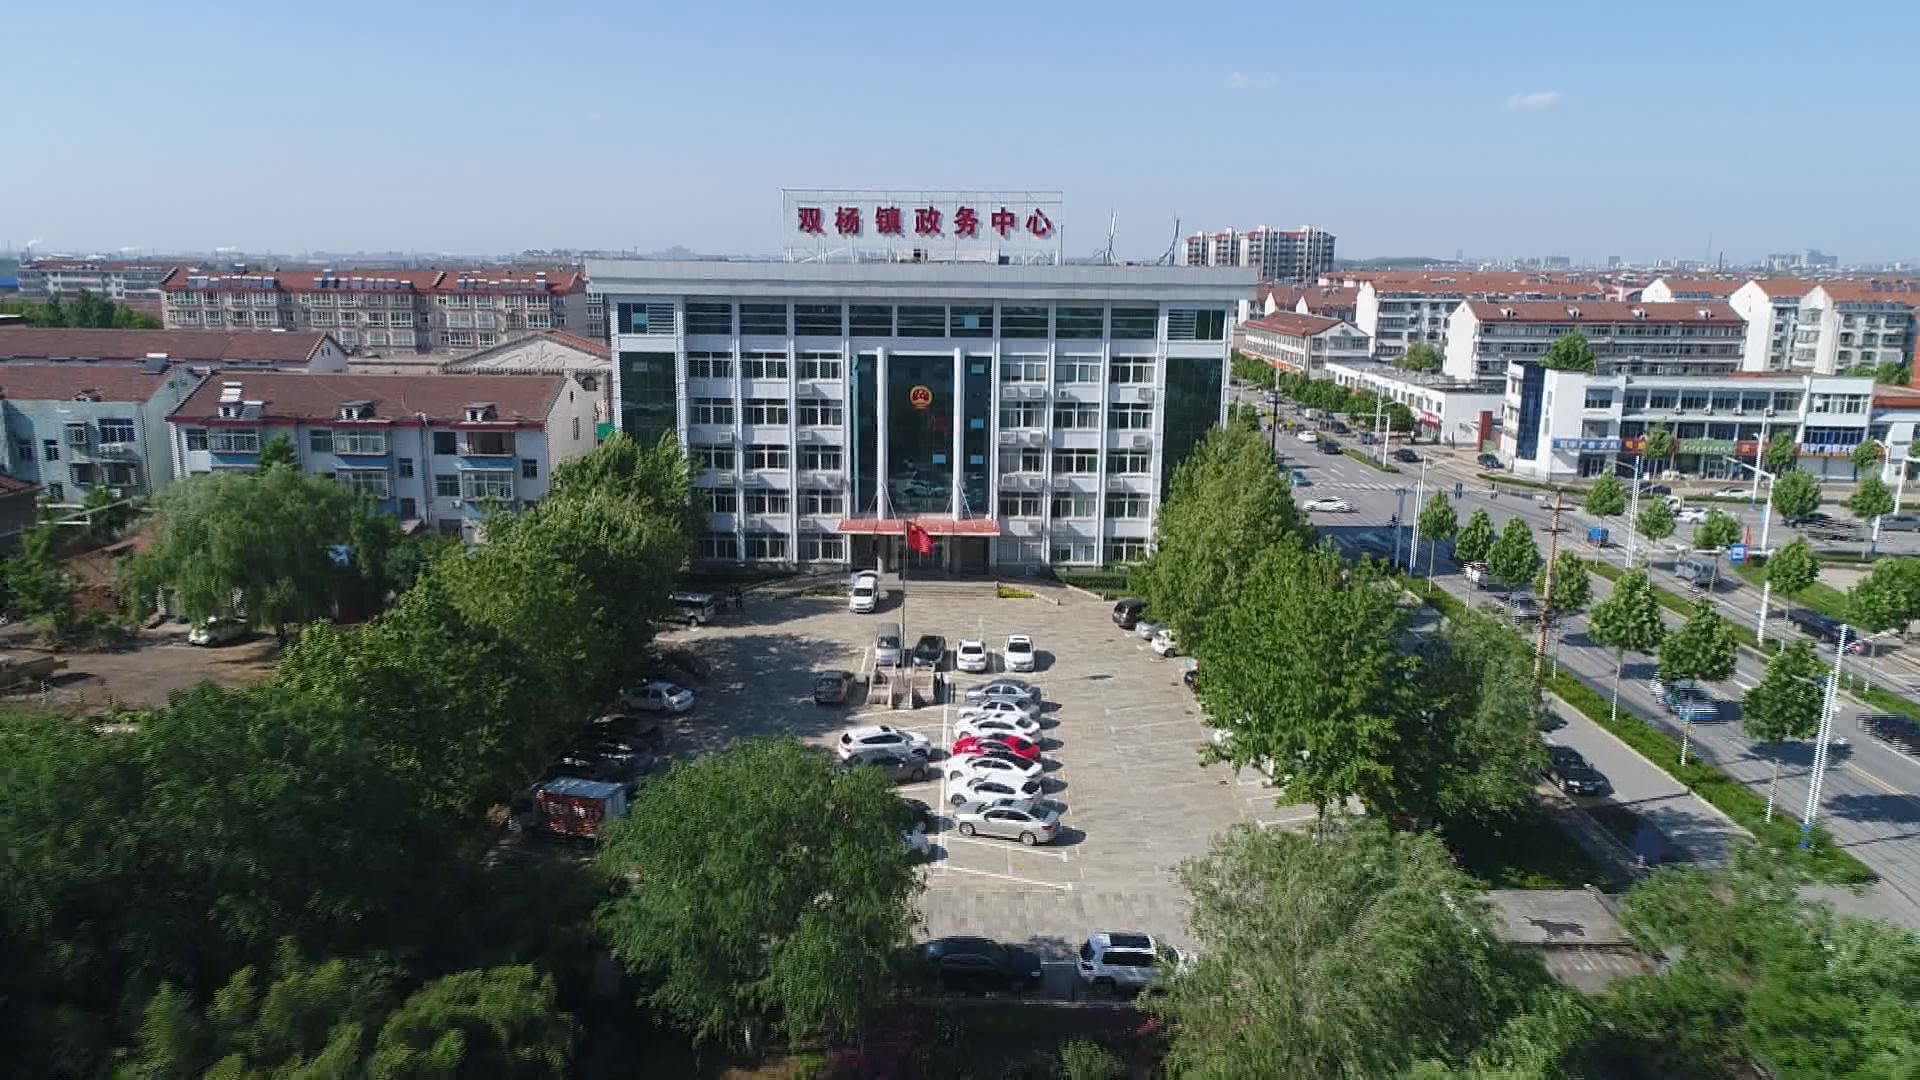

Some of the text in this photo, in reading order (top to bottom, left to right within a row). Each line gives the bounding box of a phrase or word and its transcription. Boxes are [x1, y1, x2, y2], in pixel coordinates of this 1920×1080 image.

[798, 206, 1052, 236] 双杨镇政务中心
